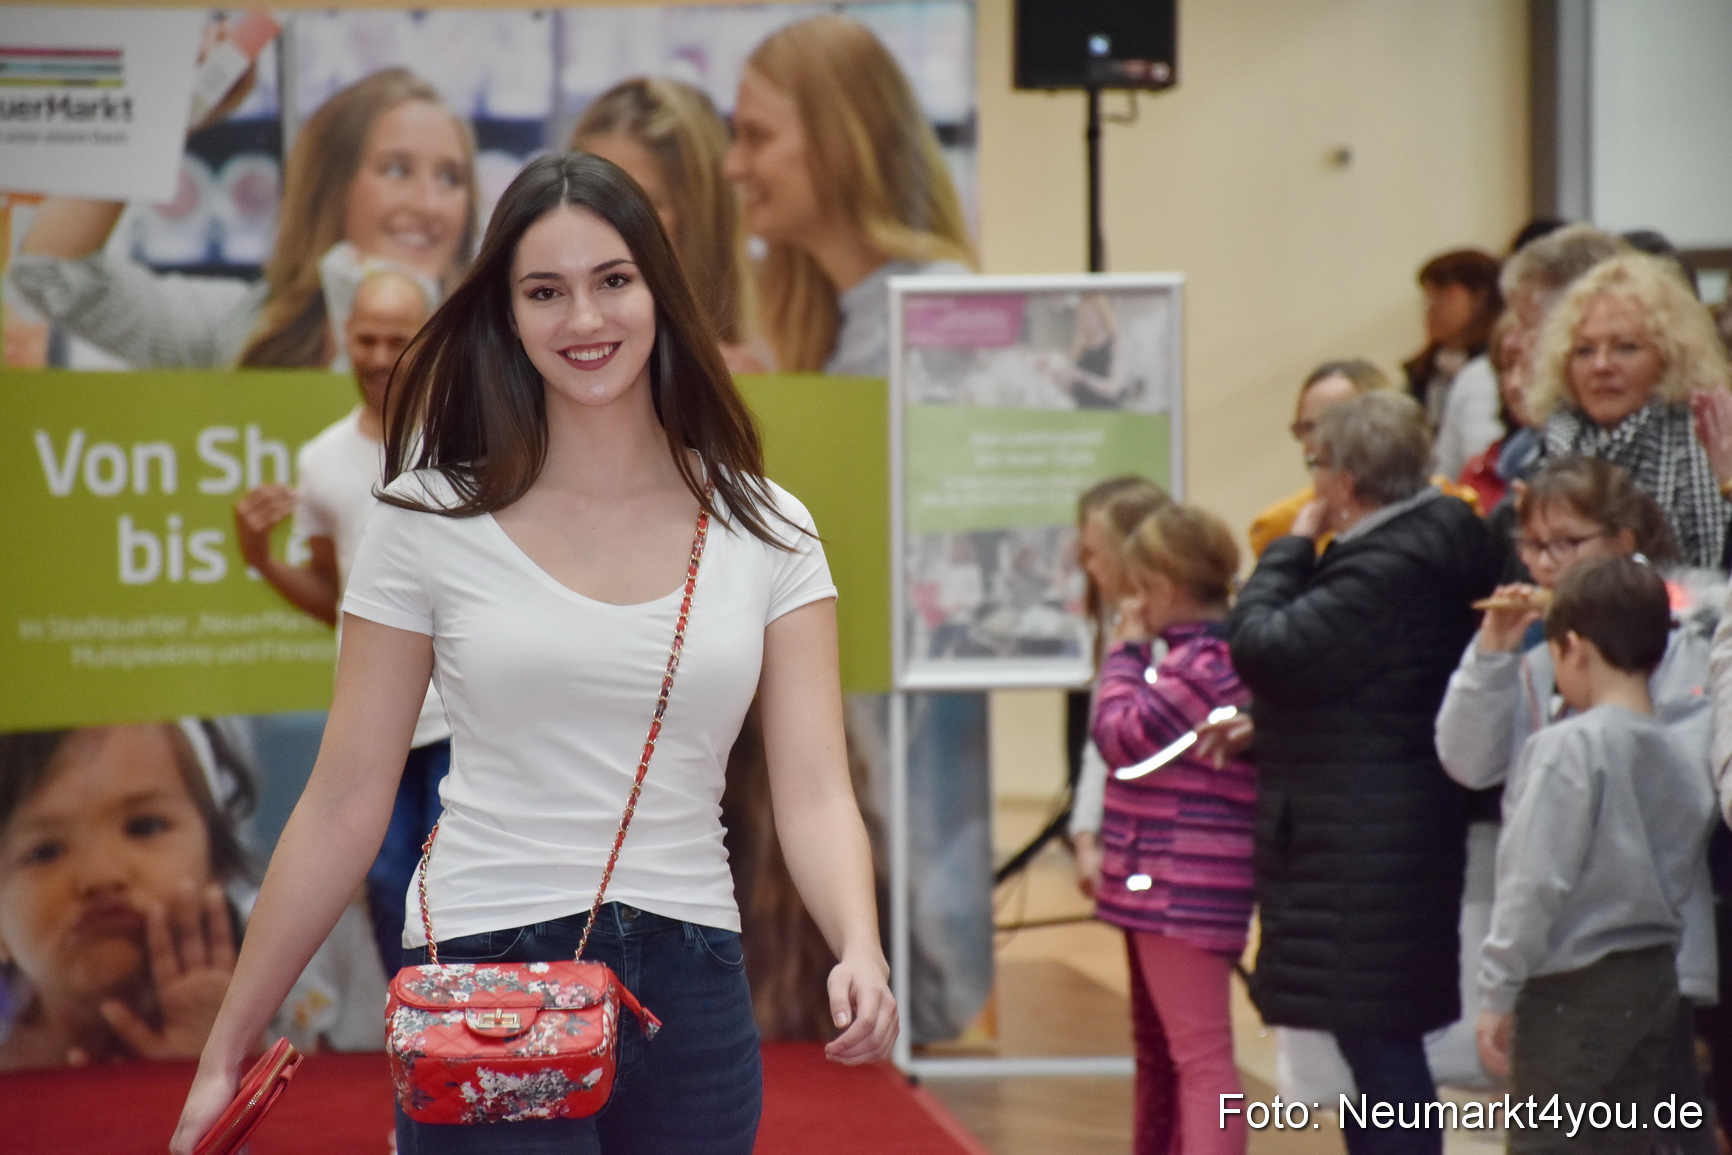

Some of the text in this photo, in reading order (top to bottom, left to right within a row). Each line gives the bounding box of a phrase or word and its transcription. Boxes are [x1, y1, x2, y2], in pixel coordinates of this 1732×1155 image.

[34, 422, 303, 496] Von Sh
[117, 514, 228, 585] bis
